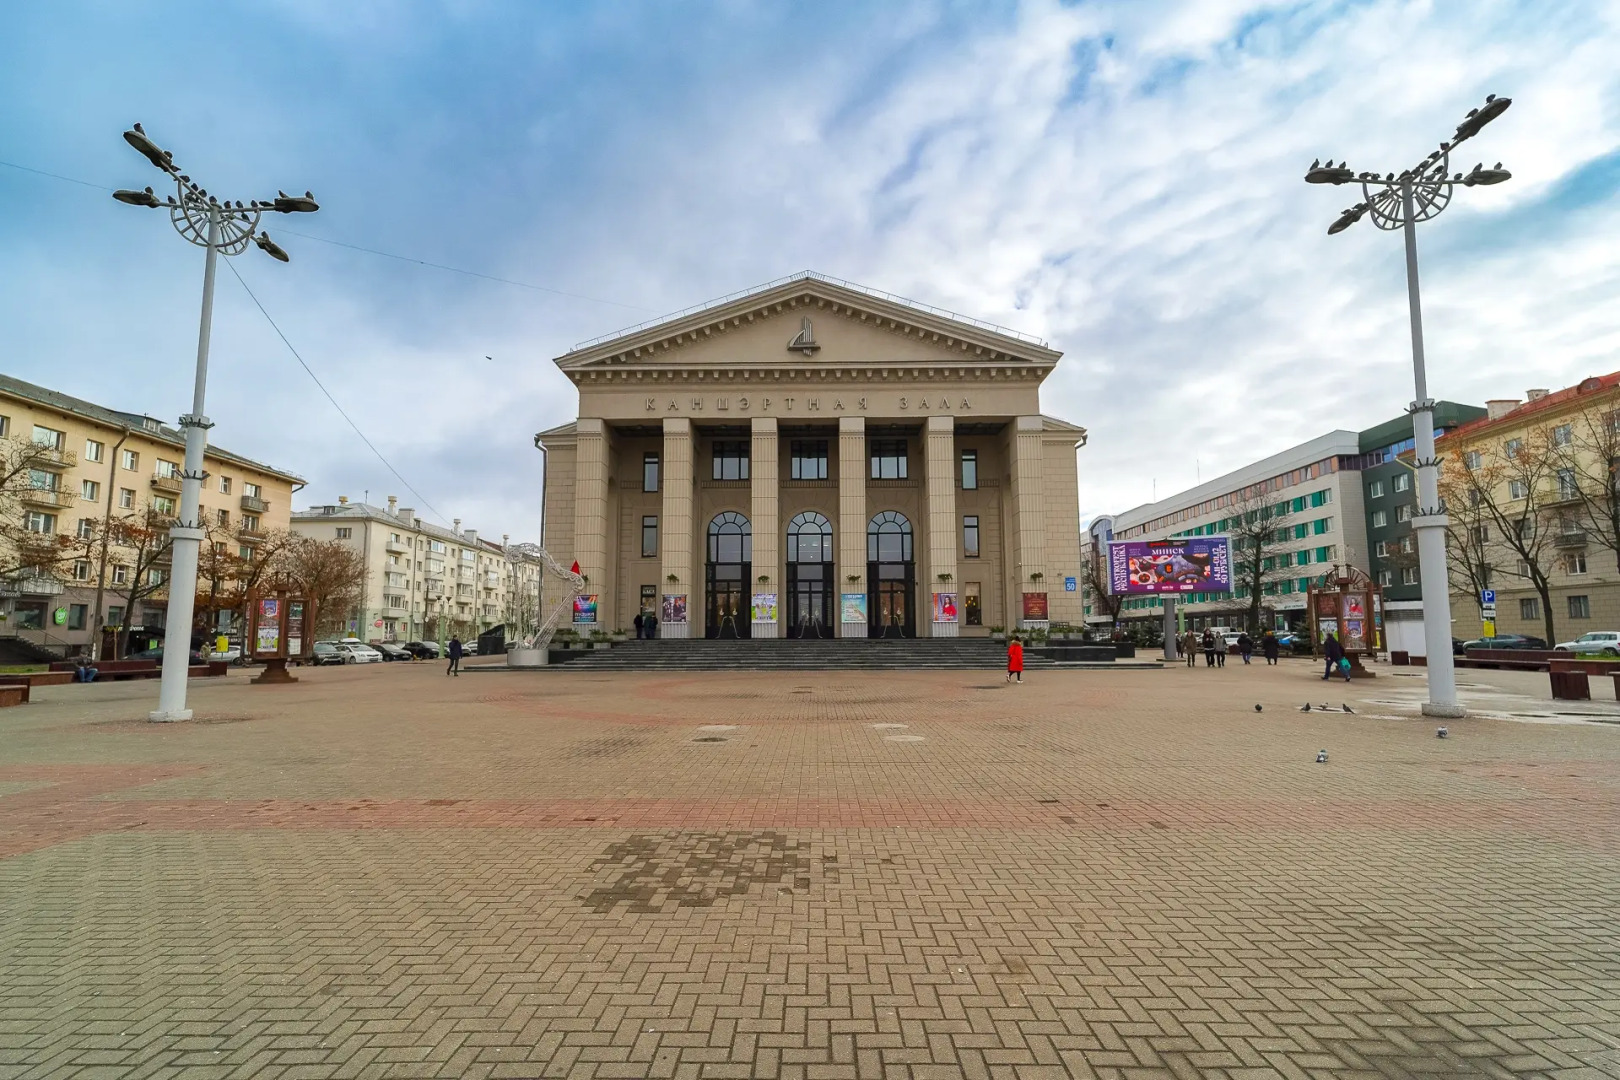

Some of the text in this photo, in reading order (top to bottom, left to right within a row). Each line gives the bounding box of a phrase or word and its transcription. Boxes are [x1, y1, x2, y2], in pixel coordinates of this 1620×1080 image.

[646, 396, 972, 411] КАНЦЭРТНАЯ ЗАЛА
[1151, 547, 1185, 555] МИНСК
[1066, 583, 1075, 591] 50
[1485, 591, 1493, 600] P
